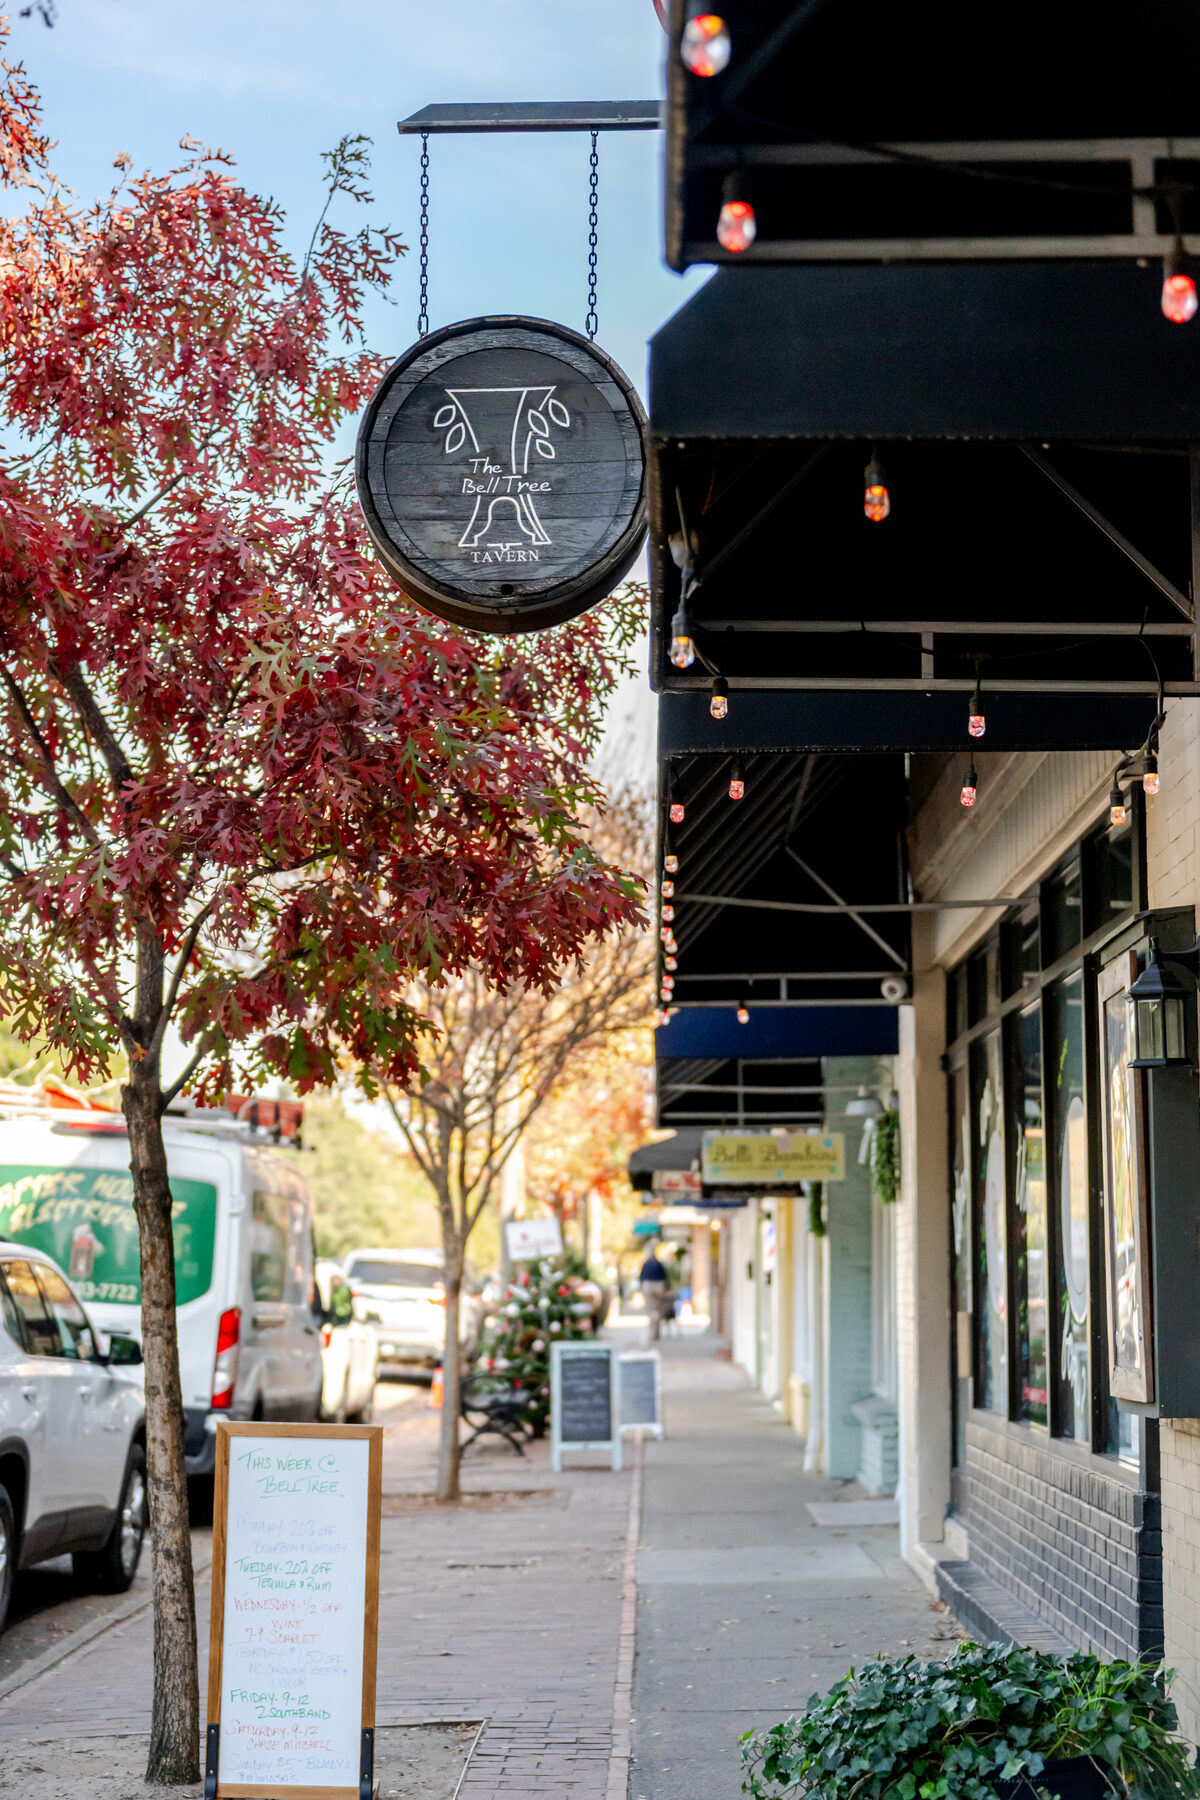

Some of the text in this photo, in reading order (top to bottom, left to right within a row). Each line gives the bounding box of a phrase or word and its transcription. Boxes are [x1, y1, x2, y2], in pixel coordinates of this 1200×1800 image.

[469, 457, 502, 474] The
[462, 476, 552, 493] Bell Tree
[471, 550, 541, 563] TAVERN
[238, 1448, 340, 1473] THIS WEEK @
[257, 1475, 339, 1493] BELL TREE
[285, 1560, 308, 1574] 20%
[311, 1562, 333, 1574] OFF
[249, 1574, 296, 1590] TEQUILA
[271, 1617, 304, 1629] WINE
[267, 1629, 320, 1644] SCARLET
[282, 1691, 310, 1706] 9-12
